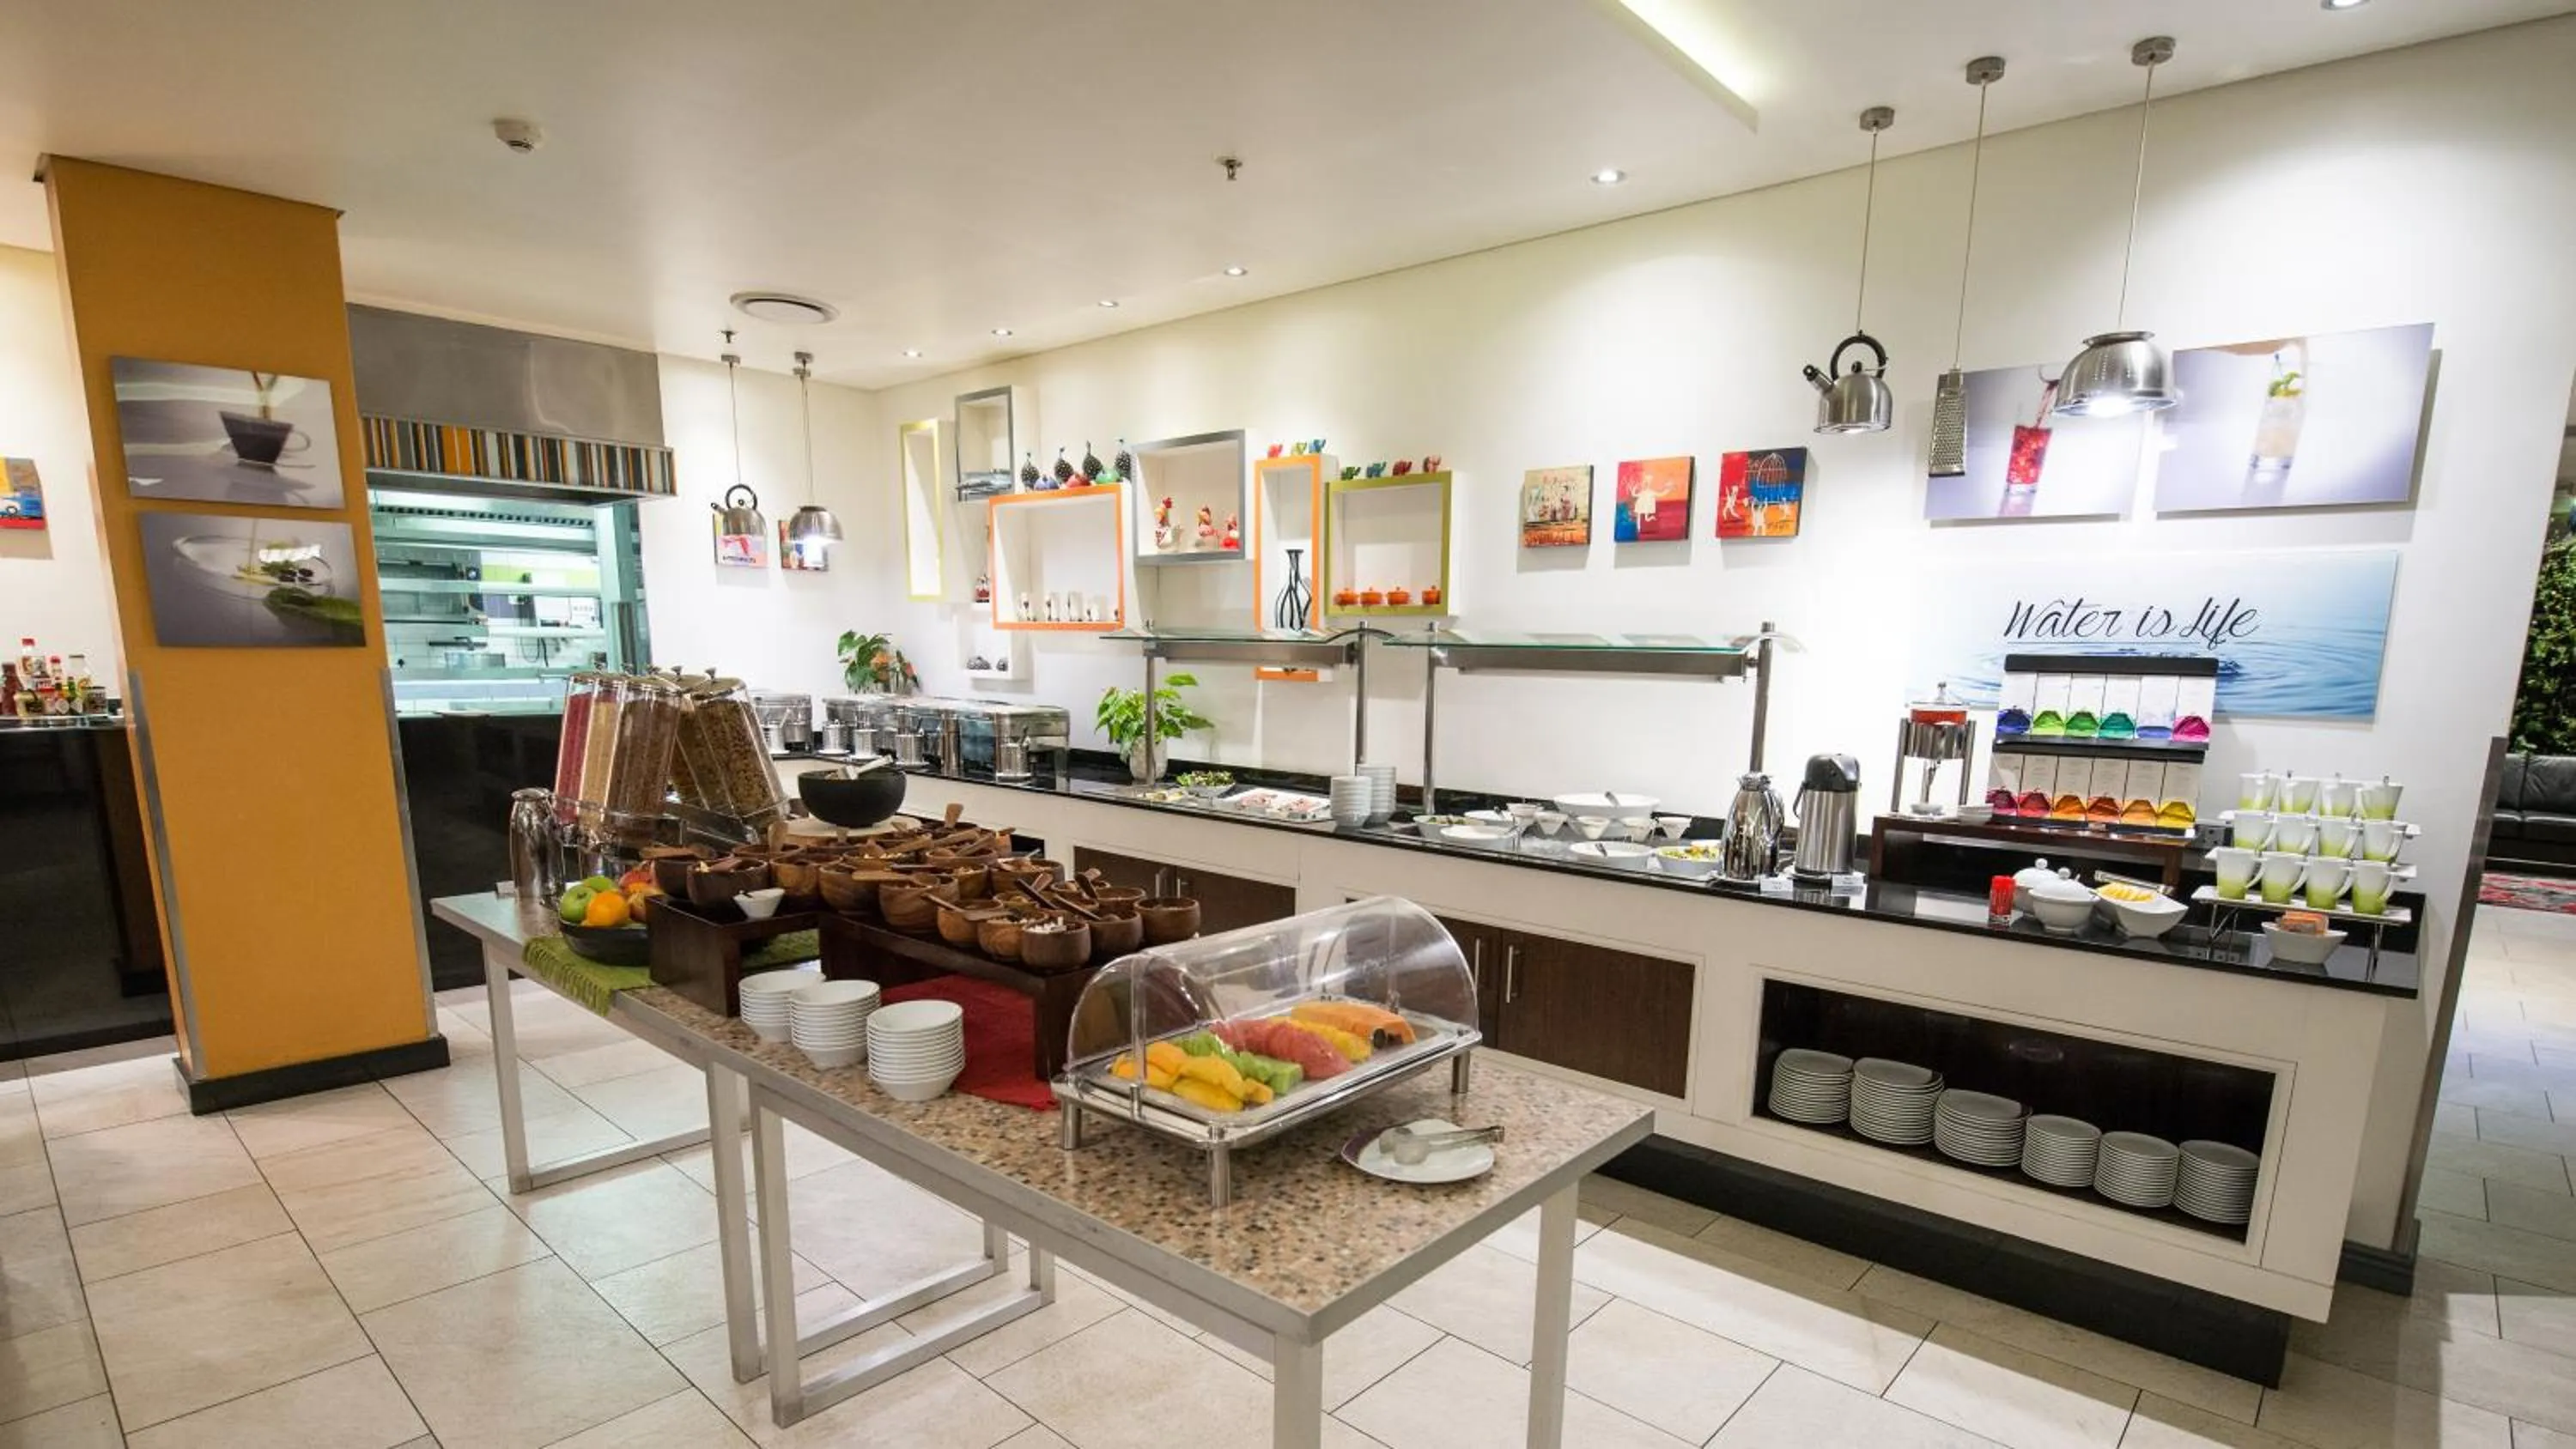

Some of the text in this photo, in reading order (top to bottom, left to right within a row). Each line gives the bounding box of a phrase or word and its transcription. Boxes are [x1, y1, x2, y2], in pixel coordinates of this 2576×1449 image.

[2004, 597, 2260, 650] Water is Life
